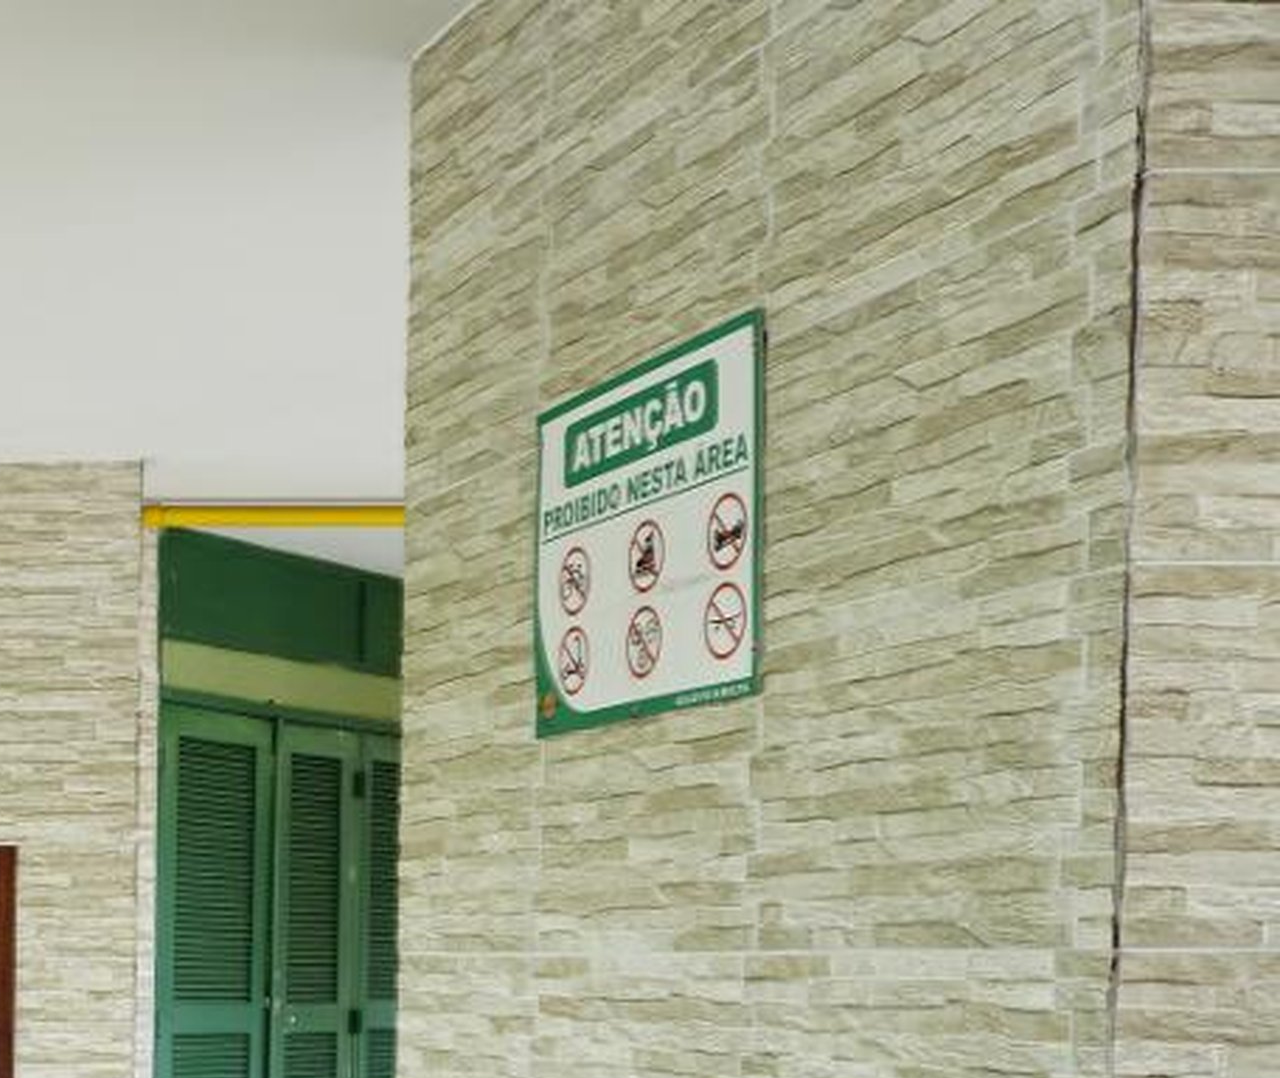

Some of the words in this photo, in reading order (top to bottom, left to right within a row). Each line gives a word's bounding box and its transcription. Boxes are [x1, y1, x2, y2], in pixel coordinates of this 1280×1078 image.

[572, 381, 706, 472] ATENÇÃO
[543, 482, 621, 537] PROIBIDO
[627, 457, 689, 504] NESTA
